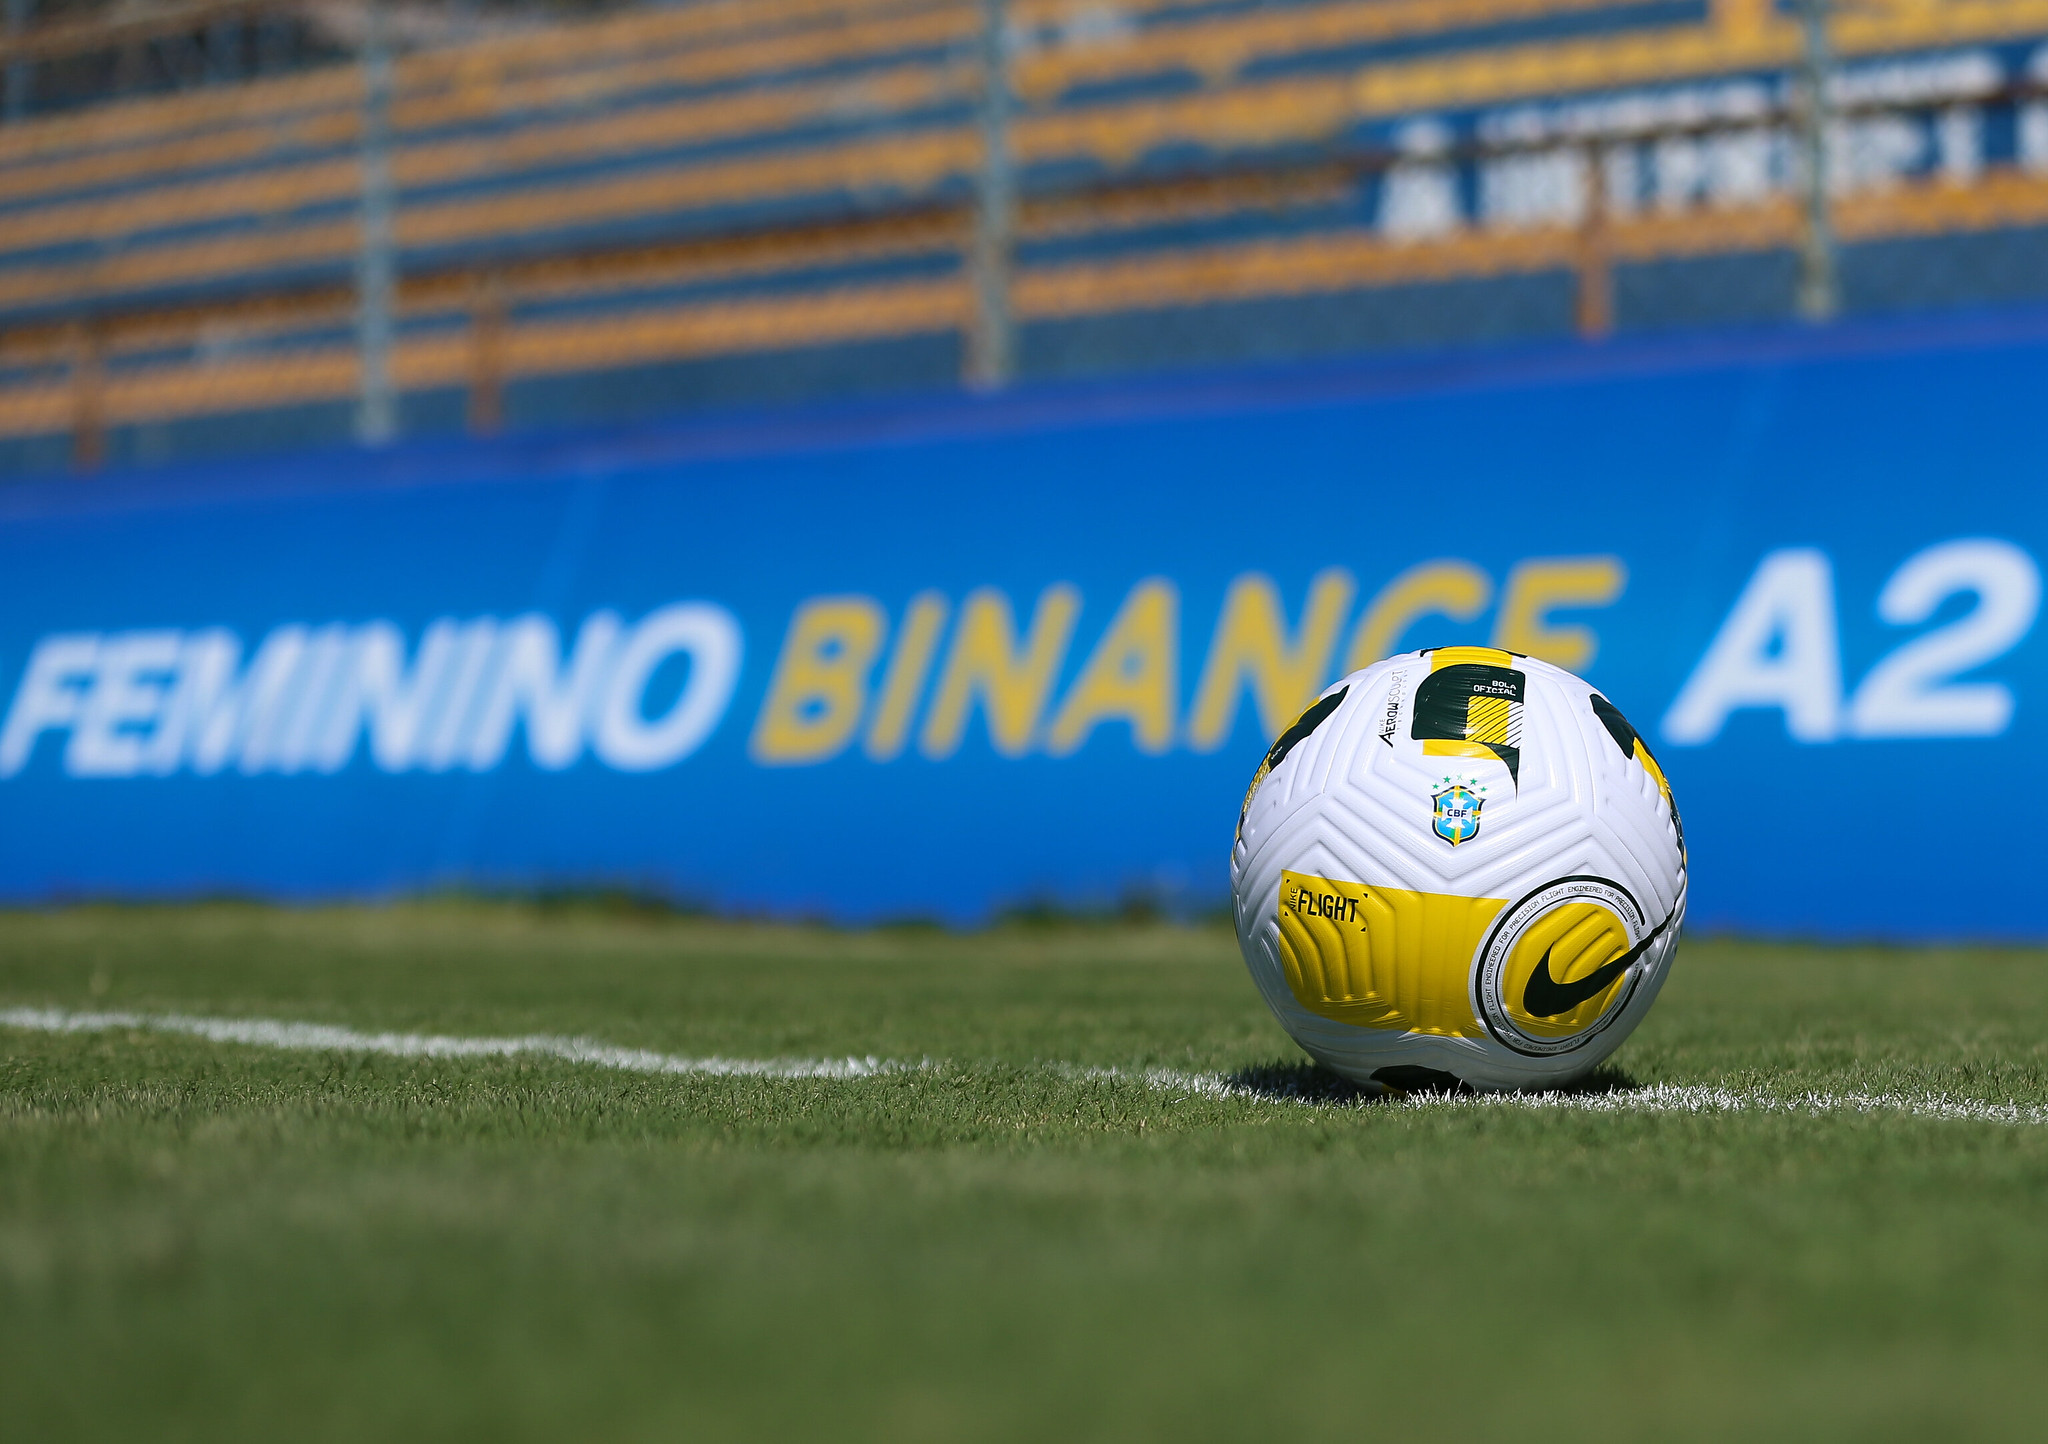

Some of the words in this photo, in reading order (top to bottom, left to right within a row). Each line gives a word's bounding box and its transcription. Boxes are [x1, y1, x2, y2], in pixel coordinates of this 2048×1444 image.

[0, 598, 746, 776] FEMININO
[1662, 537, 2041, 743] A2
[1473, 684, 1517, 697] OFICIAL
[1491, 680, 1517, 690] BOLA
[1446, 808, 1468, 818] CBF
[1289, 887, 1298, 911] NIKE
[1297, 889, 1359, 922] FLIGHT
[1499, 930, 1511, 944] FOR
[1508, 900, 1540, 931] PRECISION
[1541, 888, 1564, 902] FLIGHT
[1567, 886, 1603, 894] ENGINEERED
[1604, 890, 1615, 898] FOR
[1615, 895, 1636, 924] PRECISION
